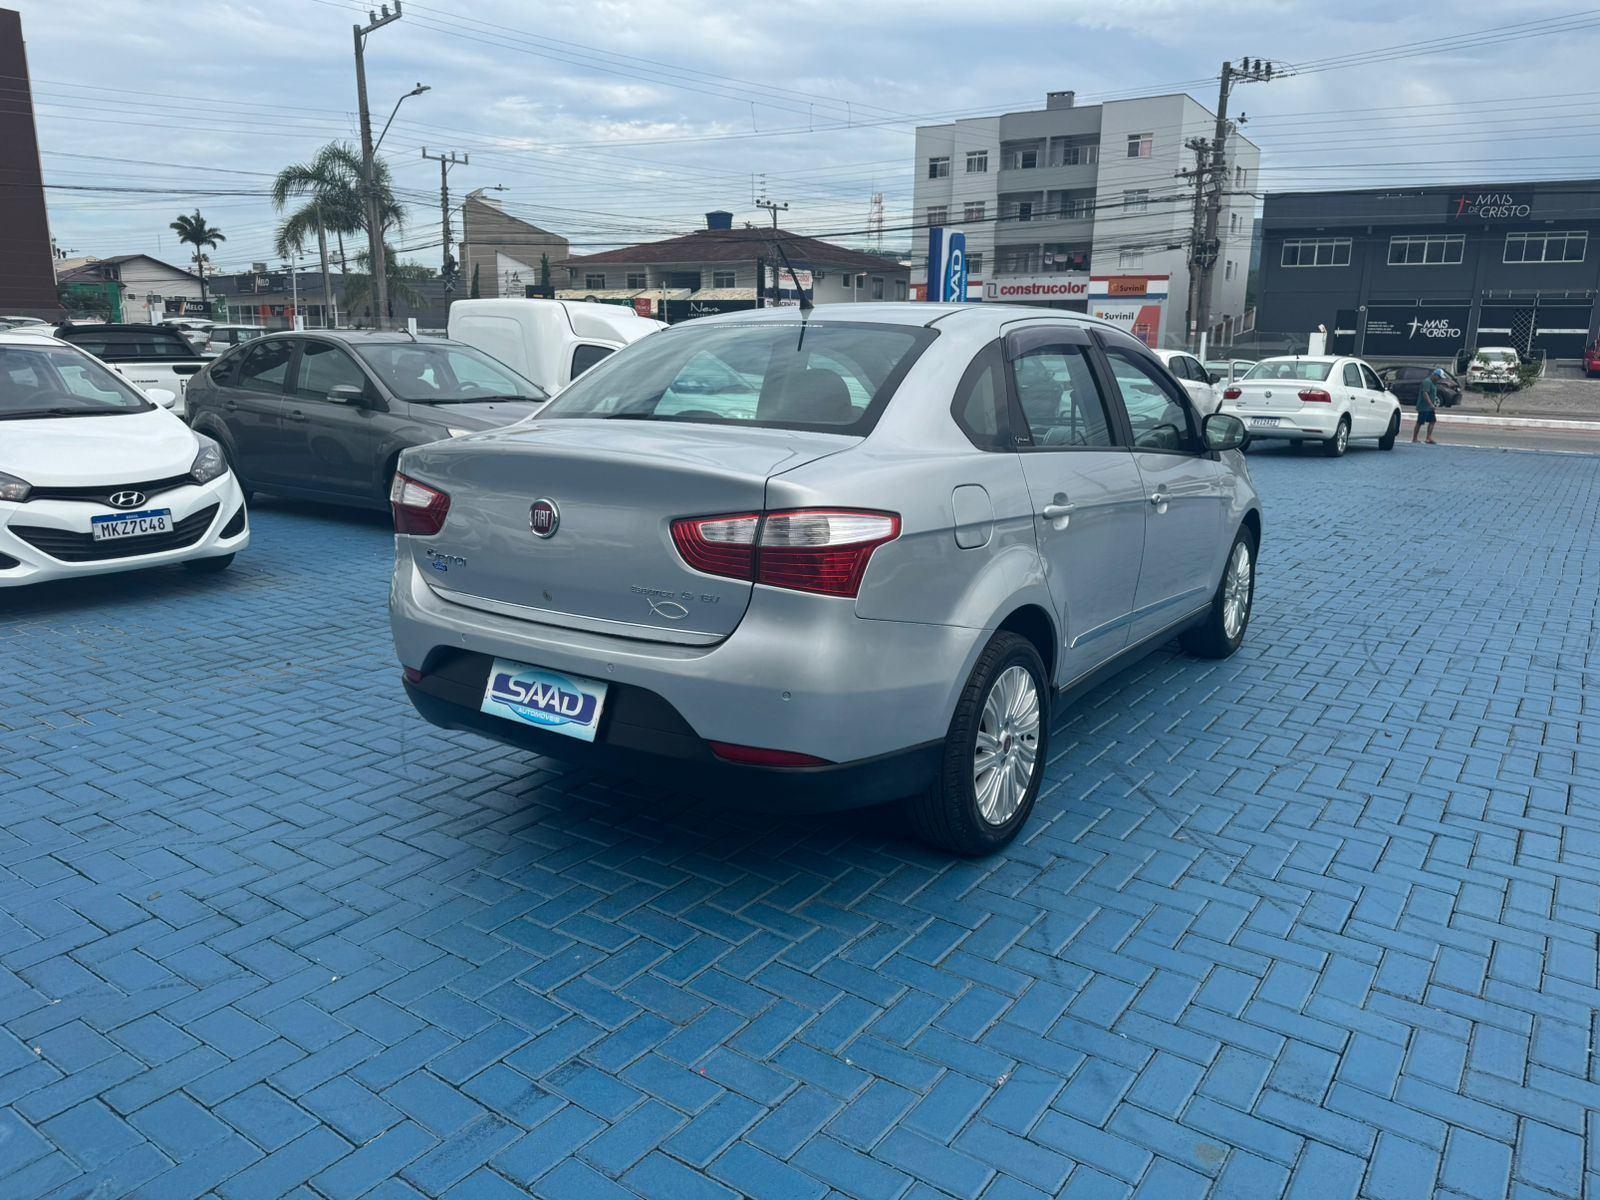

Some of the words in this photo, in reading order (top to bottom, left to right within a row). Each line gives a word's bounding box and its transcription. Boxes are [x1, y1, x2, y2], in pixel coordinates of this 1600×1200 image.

[1475, 193, 1513, 206] MAIS
[1467, 205, 1480, 214] DE
[1480, 204, 1530, 218] CRISTO
[1000, 282, 1087, 296] construcolor
[1119, 284, 1145, 293] Suvinil
[184, 302, 204, 311] MELO
[1104, 312, 1135, 321] Suvinil
[1423, 319, 1450, 329] MAIS
[1426, 328, 1461, 338] CRISTO
[534, 509, 551, 528] FIAT
[100, 517, 166, 538] MKZ7C48
[508, 679, 584, 717] SAAD
